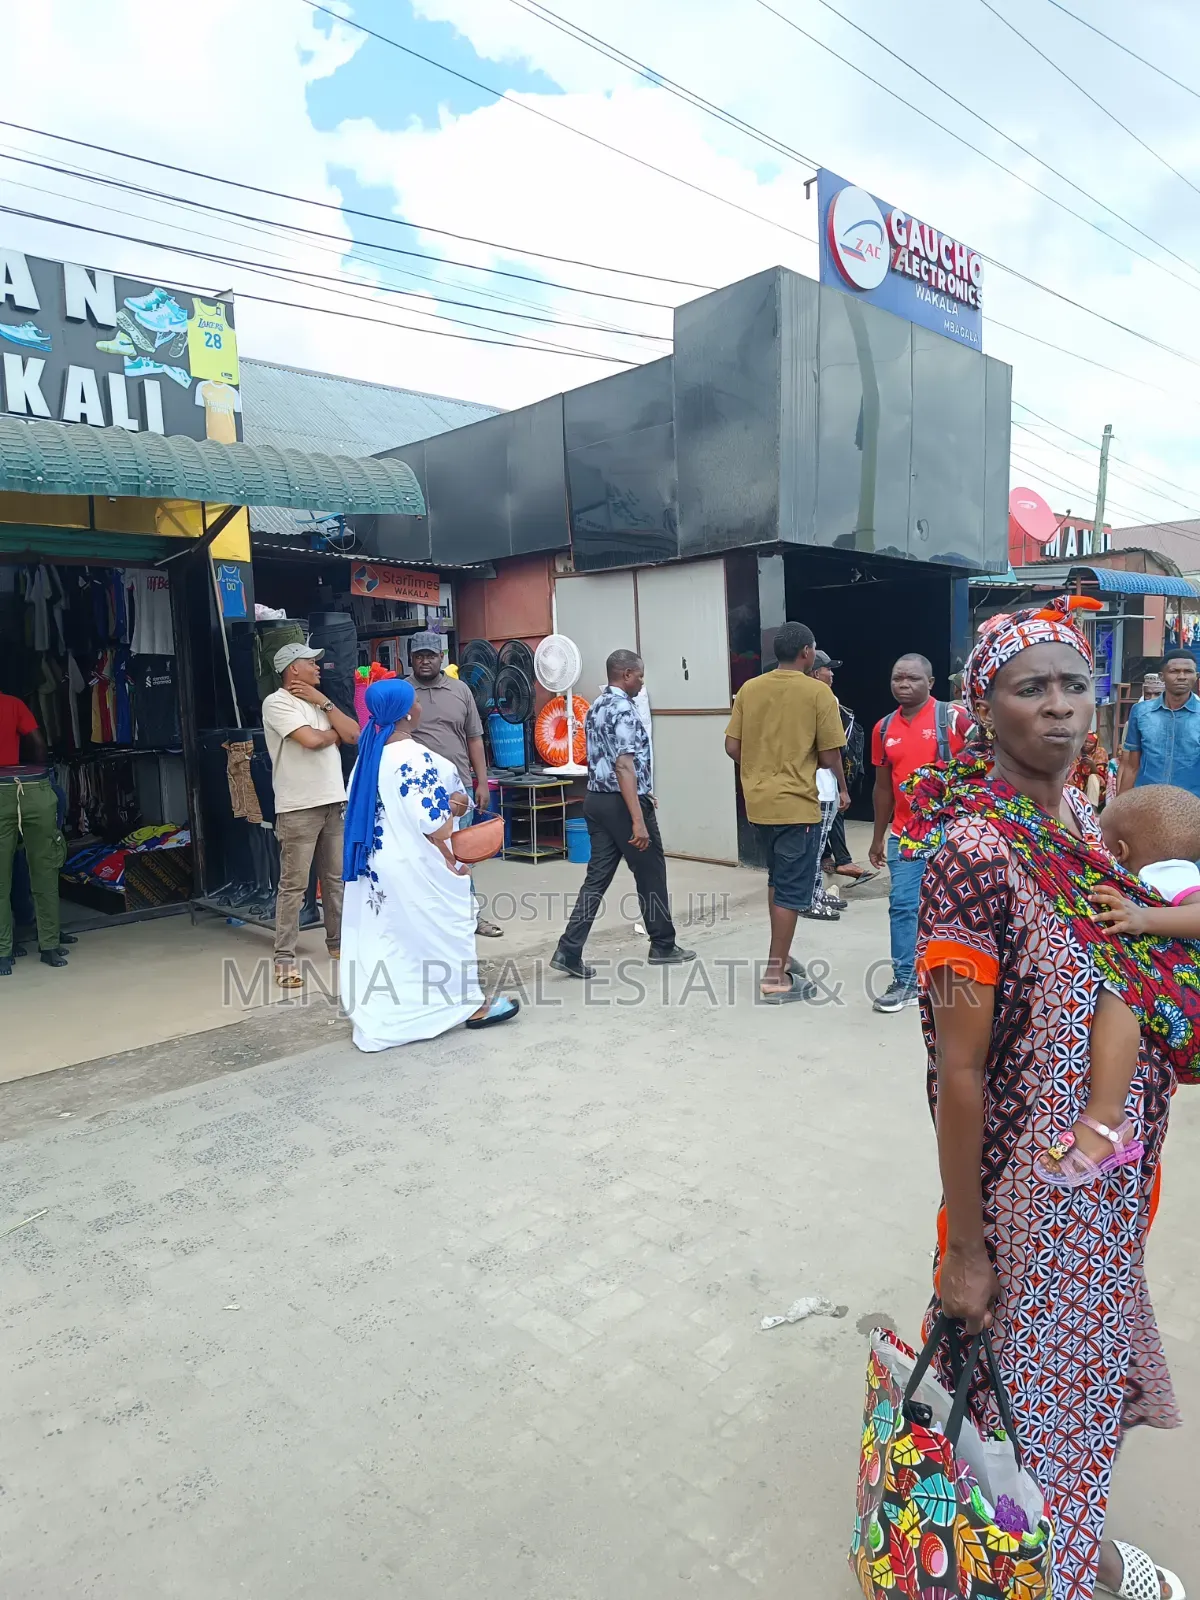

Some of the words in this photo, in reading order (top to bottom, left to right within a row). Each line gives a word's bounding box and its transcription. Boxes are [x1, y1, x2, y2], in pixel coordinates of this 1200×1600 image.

[888, 208, 984, 288] GAUCHO
[915, 283, 959, 317] WAKALA
[204, 331, 222, 350] 28
[943, 319, 979, 343] MBAGALA
[3, 352, 164, 435] KALI
[382, 571, 439, 591] StarTimes
[394, 586, 429, 598] WAKALA
